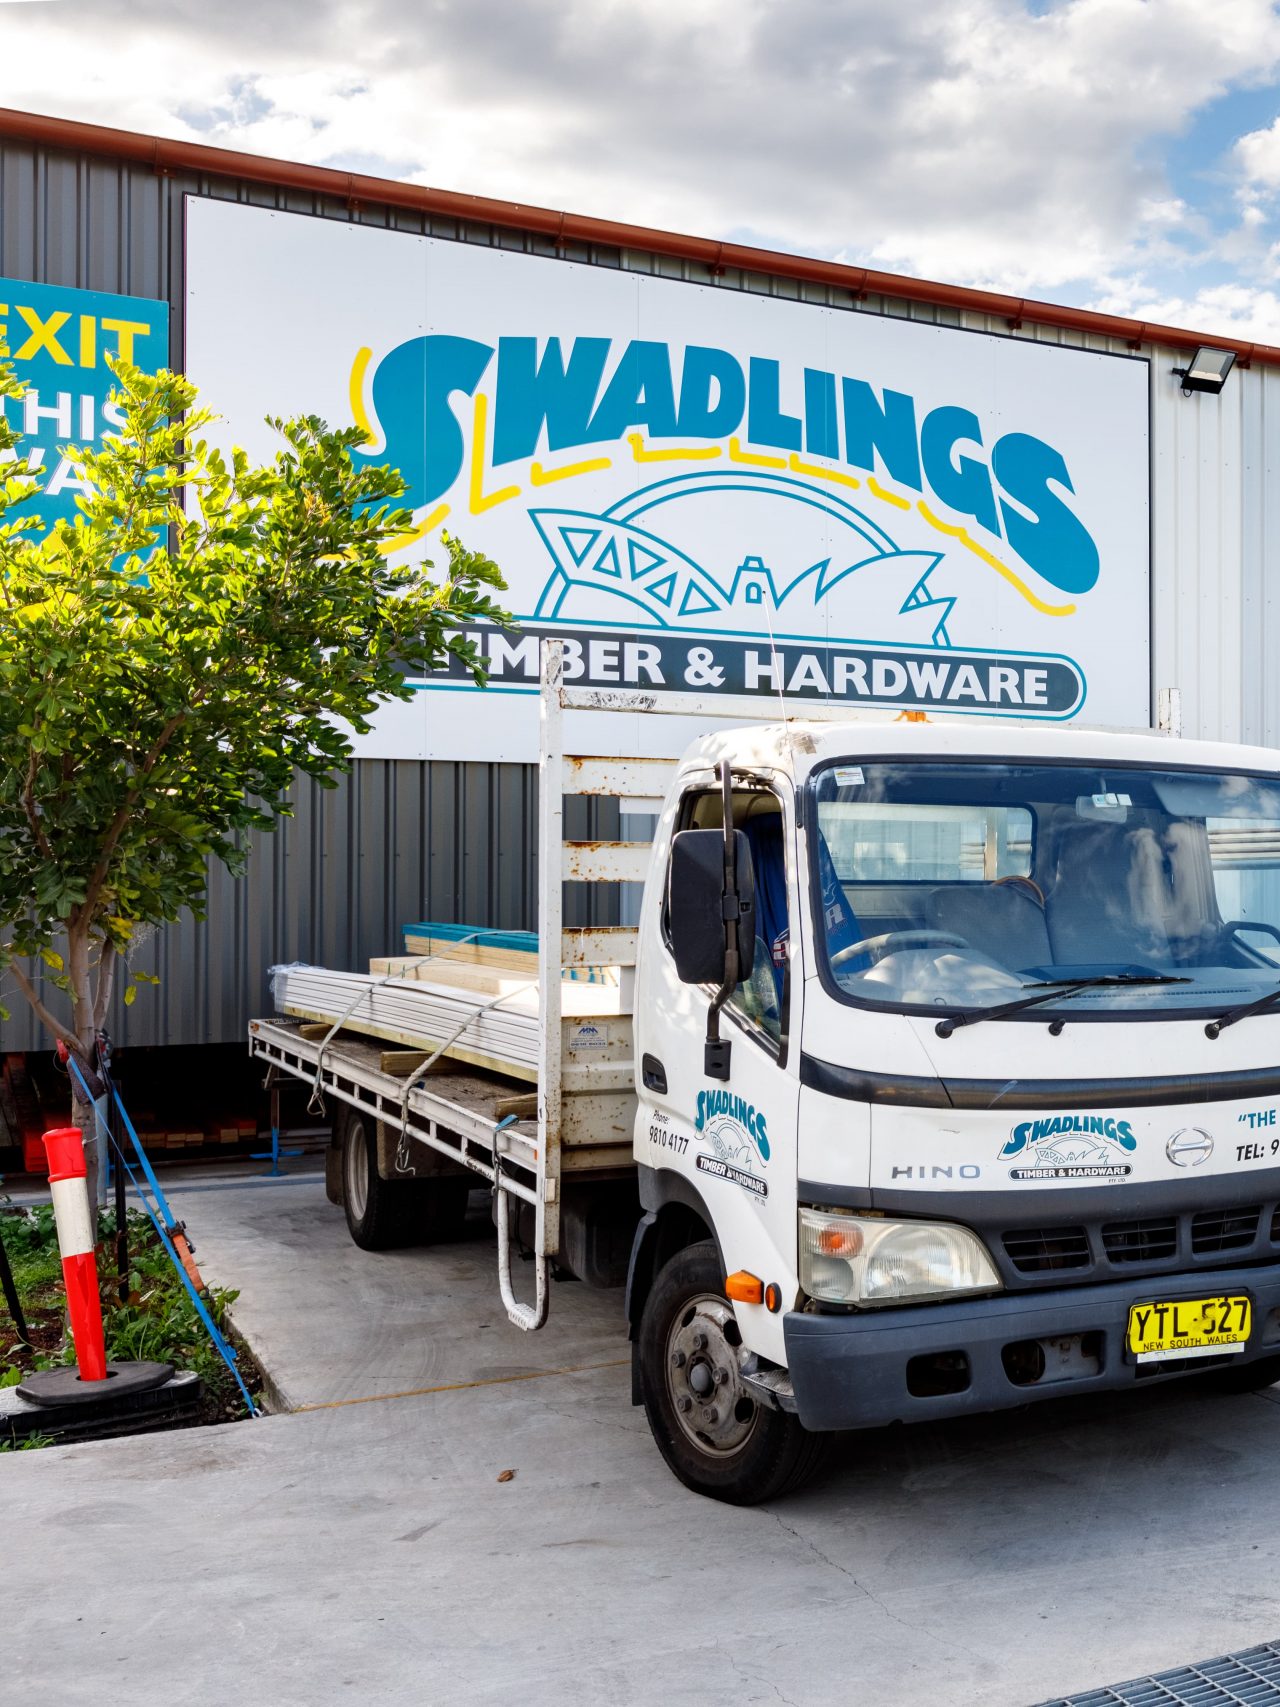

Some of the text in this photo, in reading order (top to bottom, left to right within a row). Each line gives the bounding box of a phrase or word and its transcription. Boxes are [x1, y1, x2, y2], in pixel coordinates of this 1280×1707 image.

[0, 304, 151, 369] XIT
[349, 335, 1100, 594] SWADLINGS
[683, 646, 726, 687] &
[744, 650, 1048, 705] HARDWARE
[695, 1089, 770, 1161] SWADLINGS
[1002, 1115, 1137, 1155] SWADLINGS
[649, 1126, 690, 1155] 9810 4177
[1236, 1144, 1265, 1161] TEL:
[700, 1157, 727, 1176] TIMBER
[891, 1165, 981, 1179] HINO
[1017, 1166, 1126, 1180] TIMBER & HARDWARE
[1143, 1333, 1238, 1351] NEW SOUTH WALES
